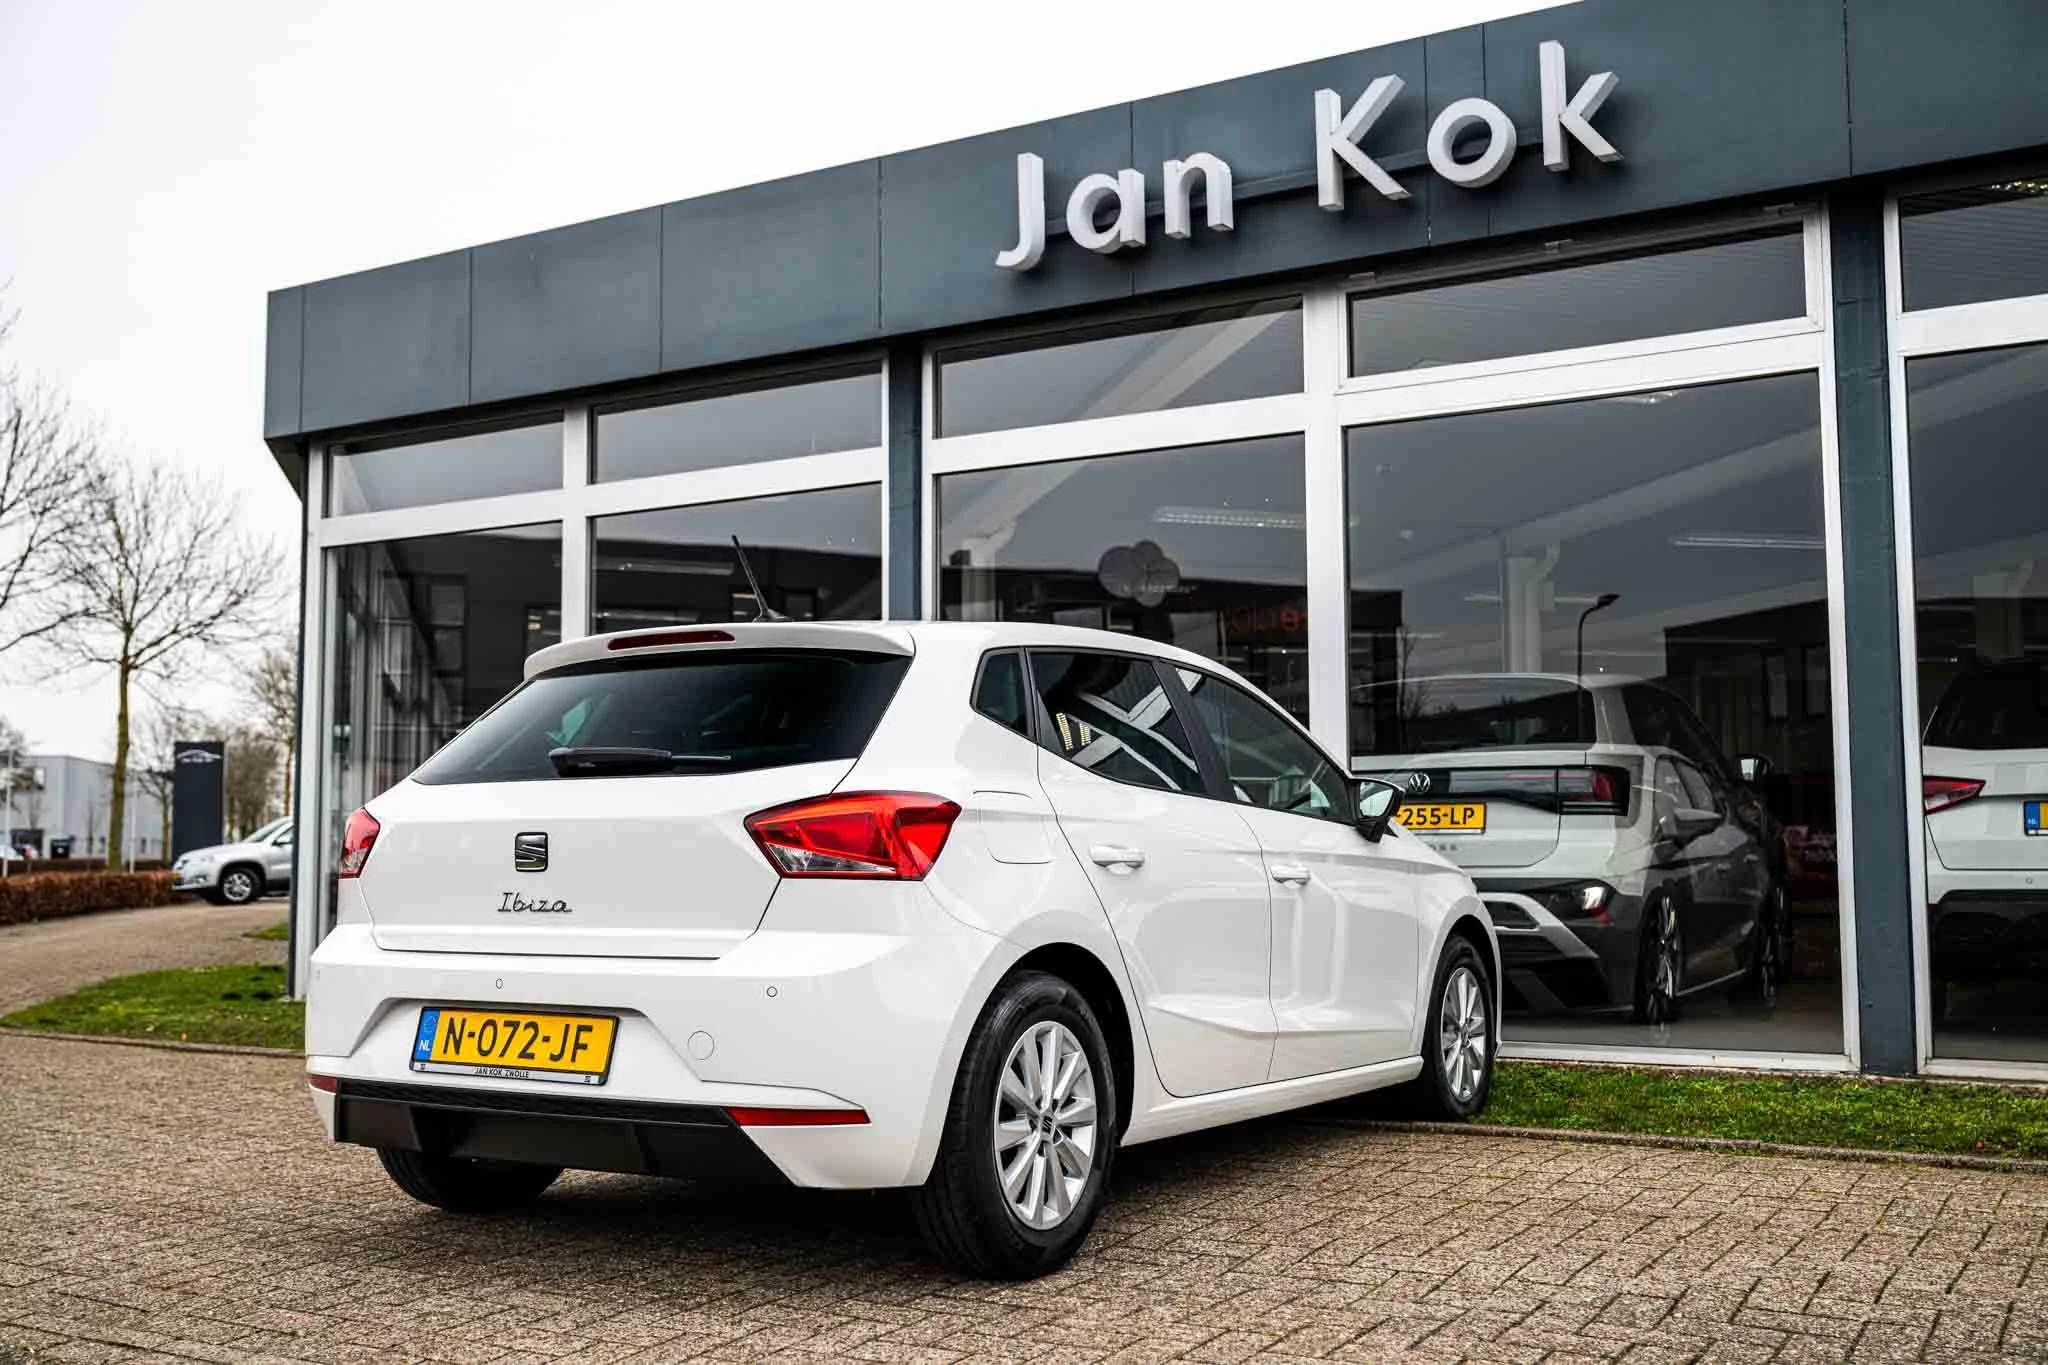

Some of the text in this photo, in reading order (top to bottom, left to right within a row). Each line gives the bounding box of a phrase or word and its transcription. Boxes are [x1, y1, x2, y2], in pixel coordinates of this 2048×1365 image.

[995, 39, 1625, 271] Jan Kok
[1396, 806, 1475, 826] -255-LP
[497, 892, 573, 912] Ibiza
[418, 1039, 431, 1052] NL
[442, 1016, 593, 1063] N-072-JF
[475, 1067, 528, 1078] JAN KOK ZWOLLE
